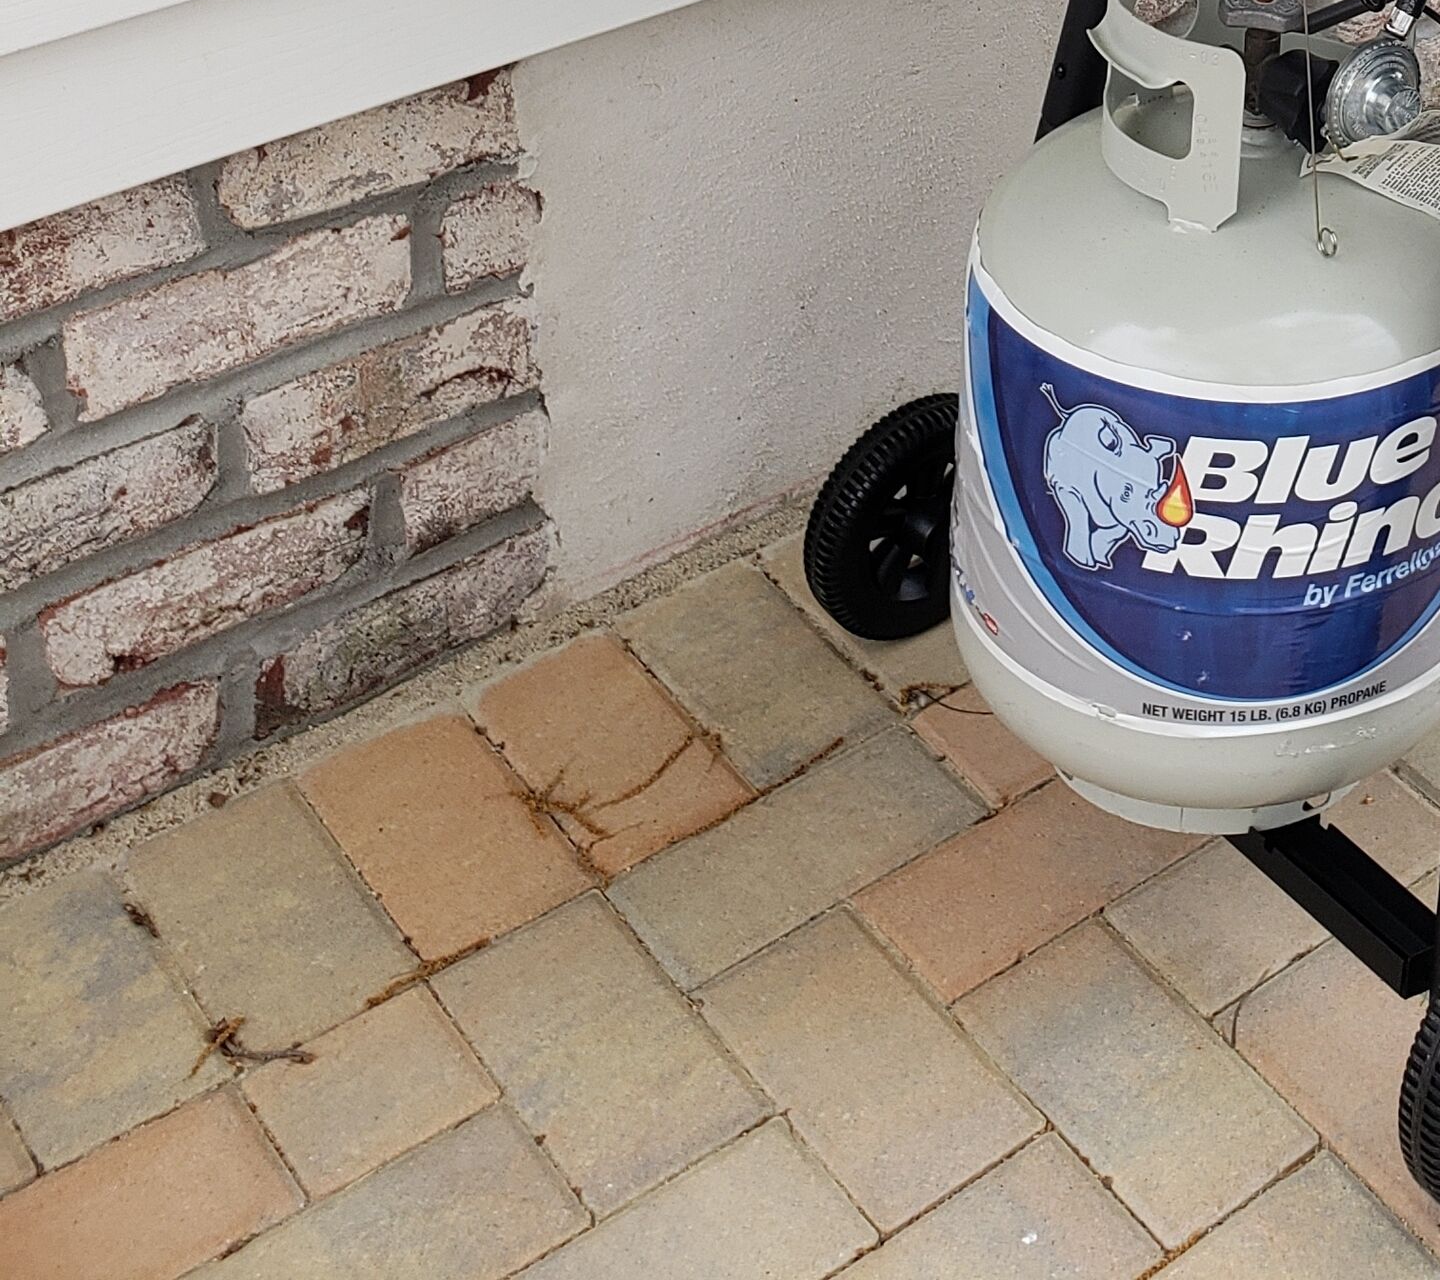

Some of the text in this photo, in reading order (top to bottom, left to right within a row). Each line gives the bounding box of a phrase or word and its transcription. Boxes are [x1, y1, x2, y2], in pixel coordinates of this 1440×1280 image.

[1181, 416, 1437, 504] Blue
[1303, 583, 1340, 608] by
[1142, 680, 1387, 722] NET WEIGHT 15 LB. (6.8 KG) PROPANE
